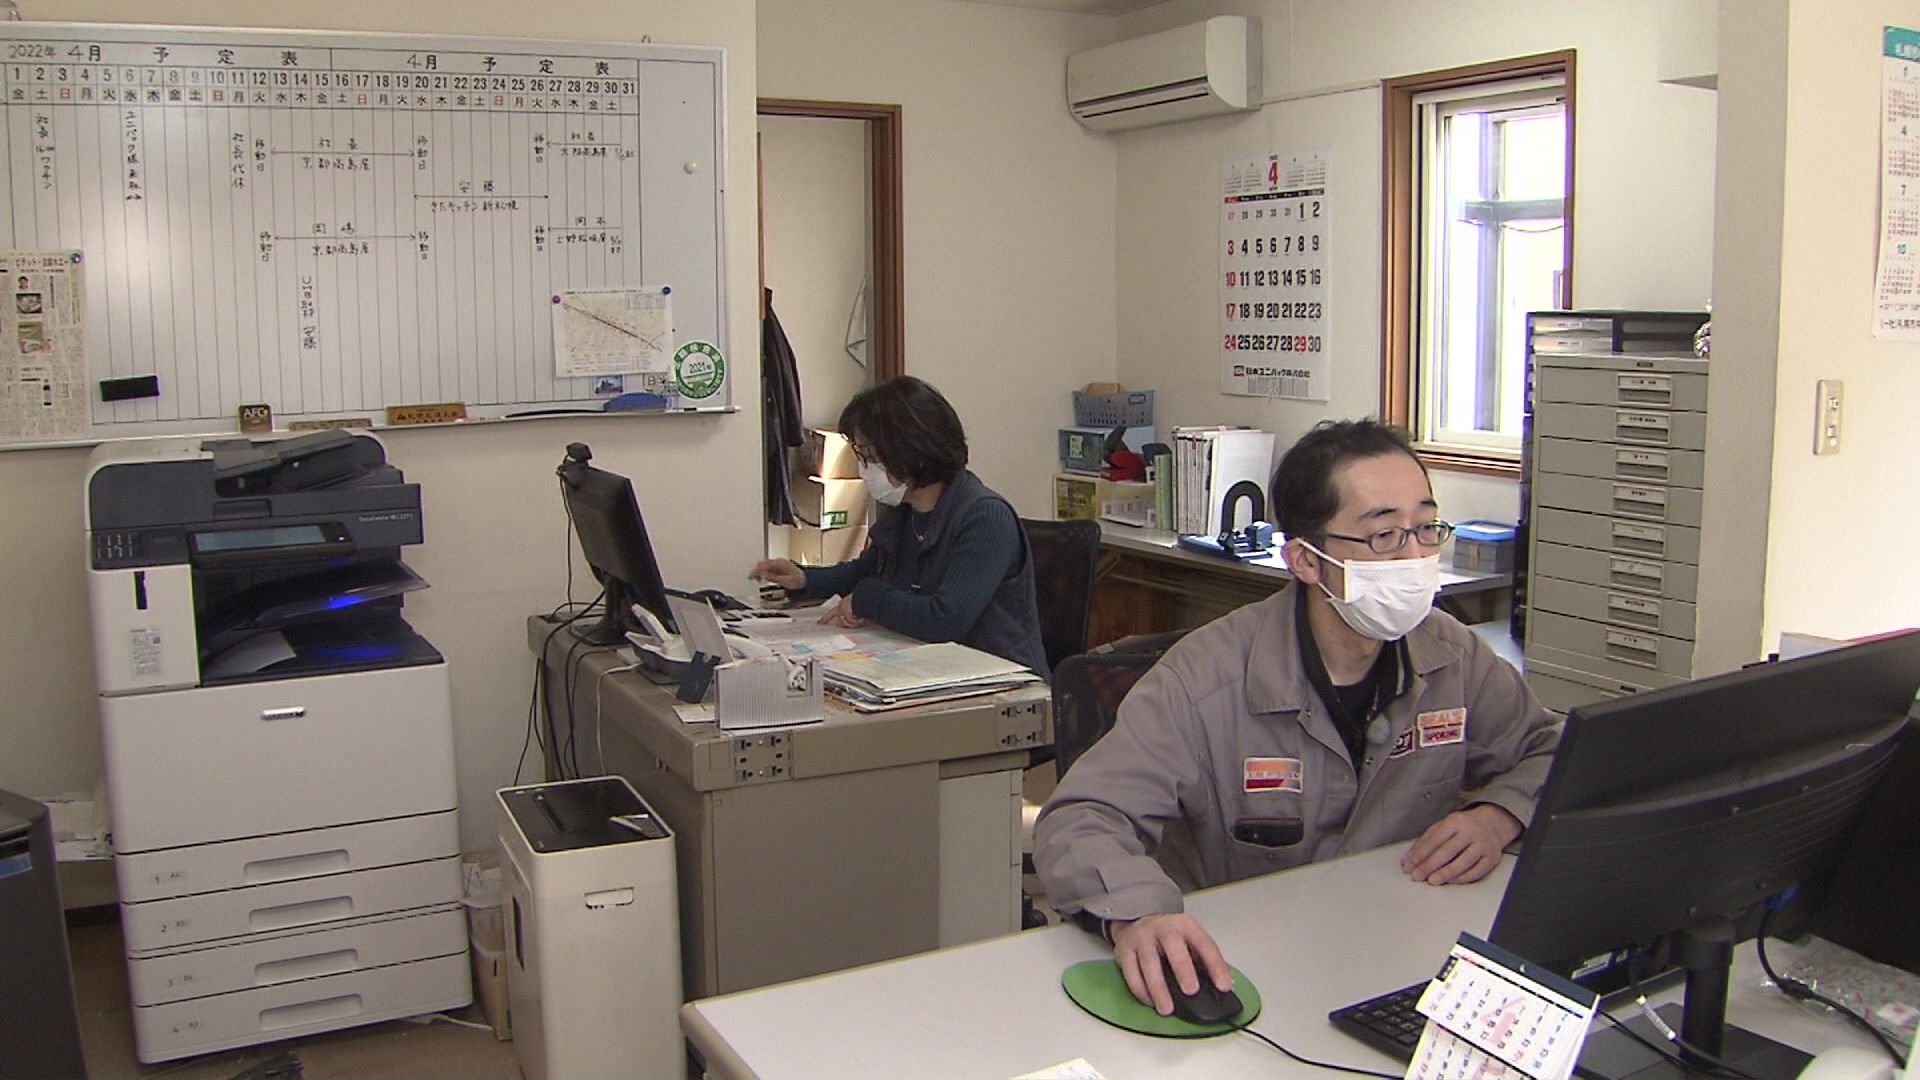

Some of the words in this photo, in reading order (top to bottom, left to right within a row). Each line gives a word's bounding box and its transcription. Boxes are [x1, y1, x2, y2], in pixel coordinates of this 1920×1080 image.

[15, 67, 19, 81] 1
[36, 67, 44, 80] 2
[58, 68, 67, 81] 3
[80, 68, 89, 80] 4
[103, 68, 111, 82] 5
[126, 69, 134, 82] 6
[147, 69, 155, 83] 7
[169, 71, 178, 83] 8
[210, 71, 224, 84] 10
[232, 72, 245, 84] 11
[253, 72, 267, 85] 12
[274, 73, 287, 85] 13
[295, 73, 307, 85] 14
[316, 74, 328, 86] 15
[336, 74, 348, 86] 16
[356, 75, 368, 87] 17
[376, 75, 389, 87] 18
[396, 76, 408, 88] 19
[416, 76, 428, 88] 20
[435, 77, 447, 88] 21
[454, 77, 467, 89] 22
[473, 77, 487, 90] 23
[492, 79, 506, 90] 24
[512, 79, 525, 90] 25
[531, 79, 544, 91] 26
[549, 80, 562, 92] 27
[567, 81, 581, 93] 28
[586, 81, 599, 93] 29
[604, 82, 618, 94] 30
[623, 82, 635, 94] 31
[1268, 162, 1278, 185] 4
[1299, 202, 1304, 218] 1
[1312, 201, 1320, 217] 2
[1227, 239, 1234, 255] 3
[1241, 239, 1248, 255] 4
[1256, 238, 1263, 254] 5
[1270, 237, 1277, 253] 6
[1284, 236, 1291, 252] 7
[1298, 235, 1305, 252] 8
[1312, 235, 1319, 251] 9
[1226, 271, 1236, 287] 10
[1240, 271, 1249, 286] 11
[1254, 270, 1264, 286] 12
[1268, 270, 1278, 286] 13
[1282, 270, 1292, 286] 14
[1296, 269, 1306, 286] 15
[1310, 269, 1321, 285] 16
[1226, 303, 1236, 318] 17
[1240, 303, 1250, 319] 18
[1254, 303, 1264, 318] 19
[1267, 303, 1279, 318] 20
[1281, 303, 1292, 318] 21
[1294, 303, 1307, 318] 22
[1308, 302, 1321, 319] 23
[1224, 335, 1236, 350] 24
[1238, 335, 1250, 350] 25
[1252, 335, 1265, 350] 26
[1266, 335, 1279, 350] 27
[1280, 335, 1292, 351] 28
[1294, 335, 1307, 352] 29
[1308, 336, 1321, 352] 30
